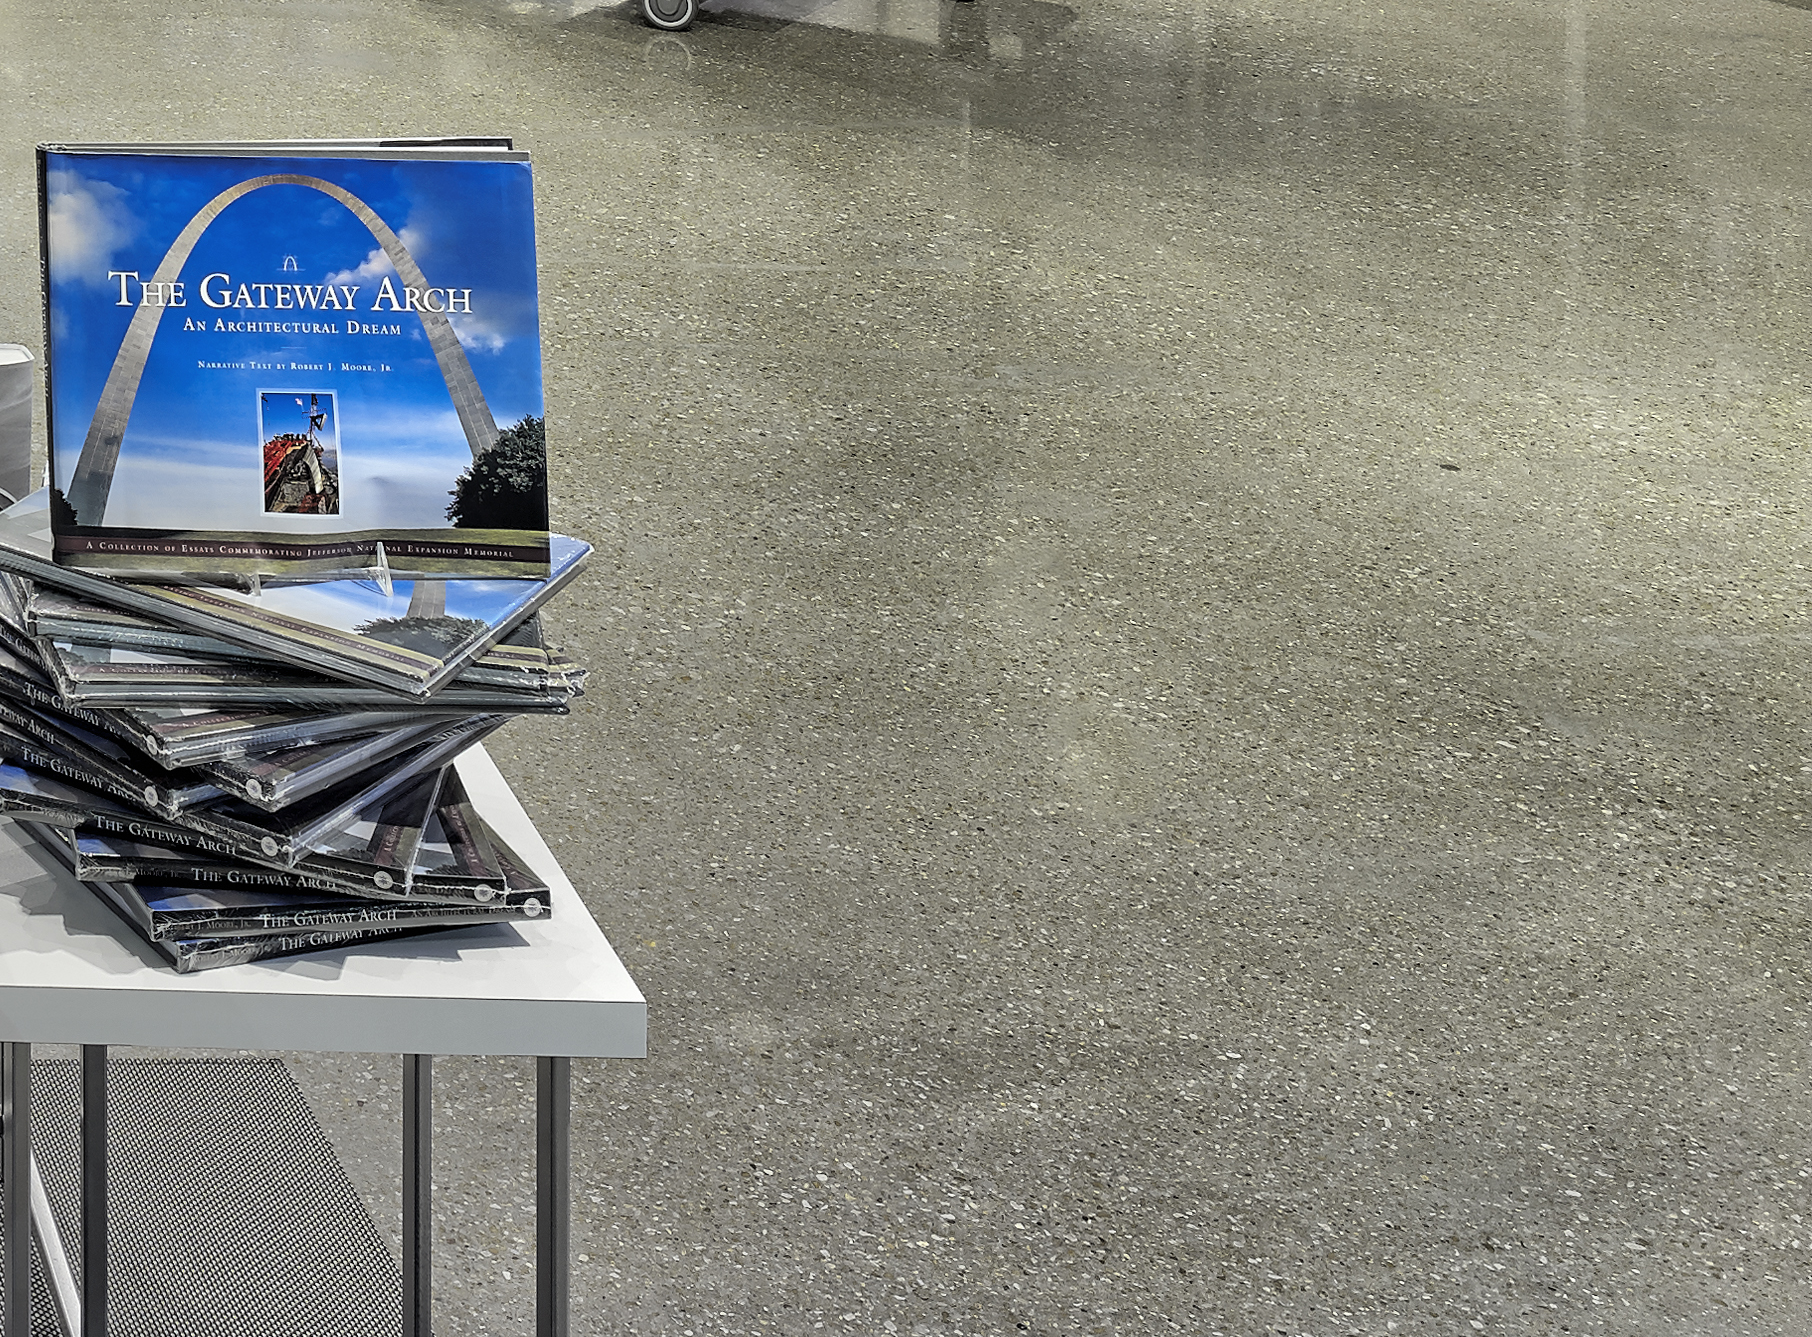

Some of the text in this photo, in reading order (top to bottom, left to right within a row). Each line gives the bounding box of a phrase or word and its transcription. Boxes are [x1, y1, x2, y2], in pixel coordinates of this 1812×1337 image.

[107, 269, 473, 315] THE GATEWAY ARCH
